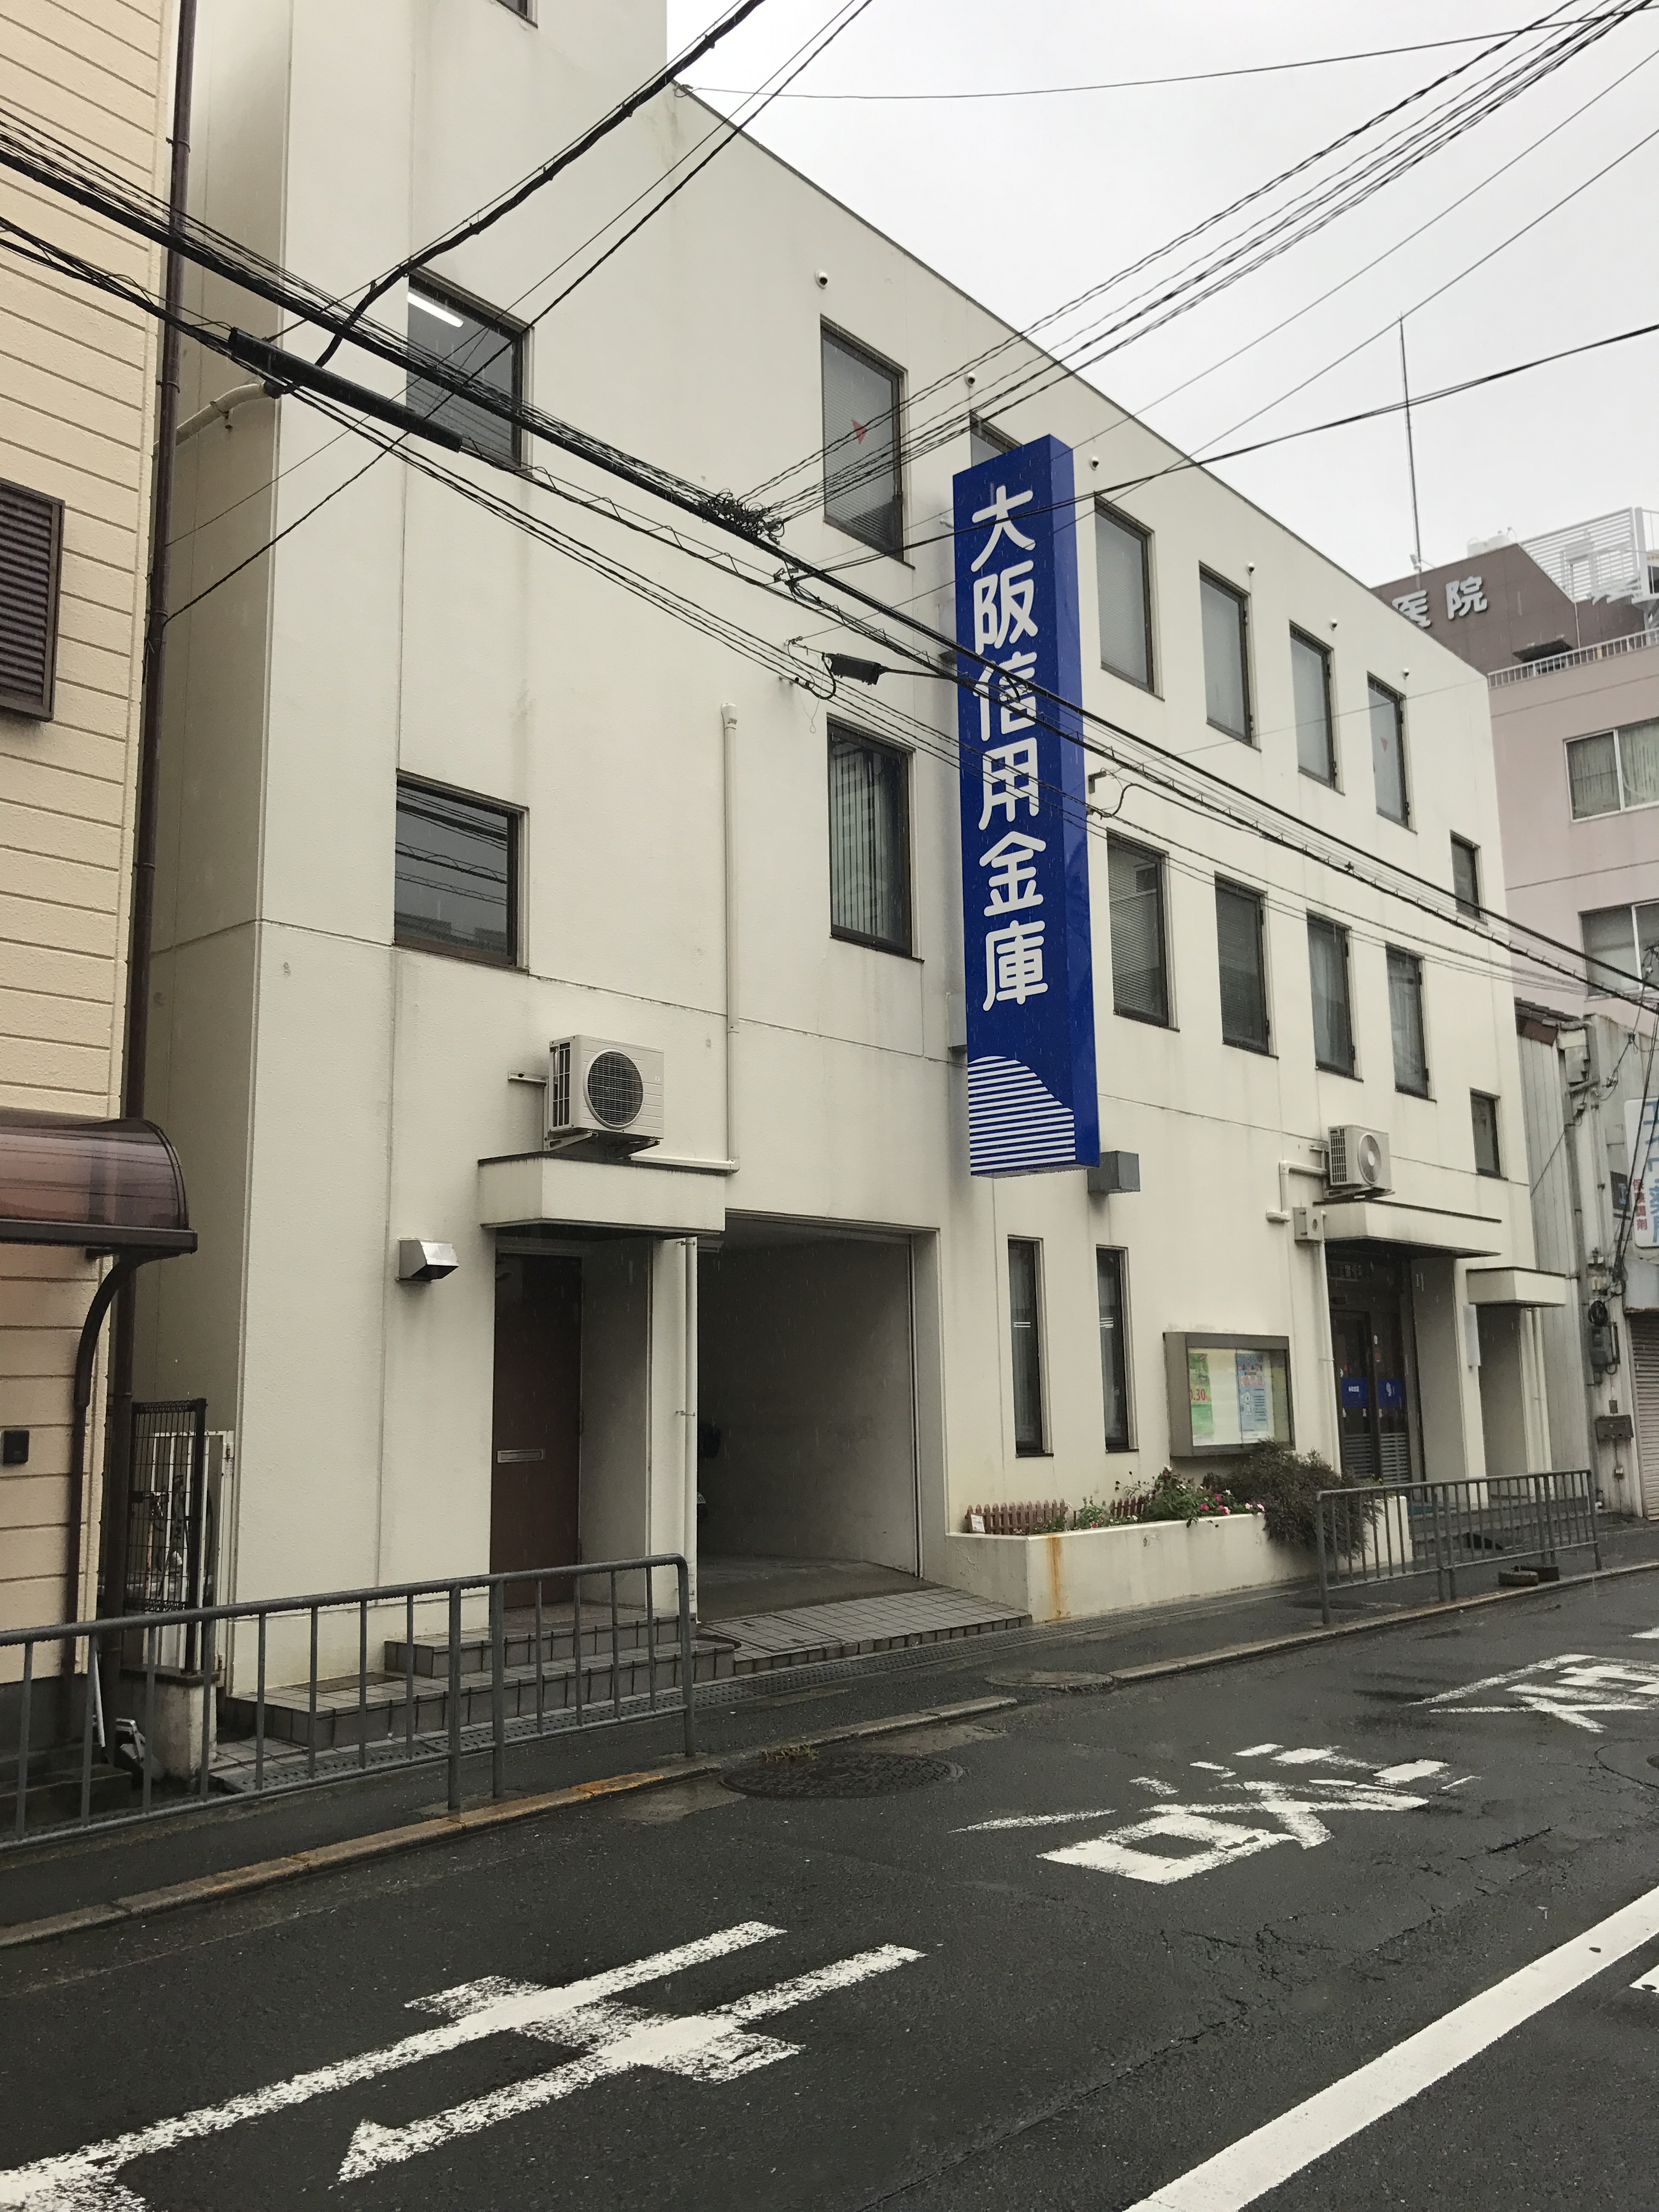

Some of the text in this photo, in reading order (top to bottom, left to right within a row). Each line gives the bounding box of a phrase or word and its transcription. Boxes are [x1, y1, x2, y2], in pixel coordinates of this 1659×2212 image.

[1391, 575, 1488, 628] 医院
[970, 485, 1048, 1011] 大阪信用金庫
